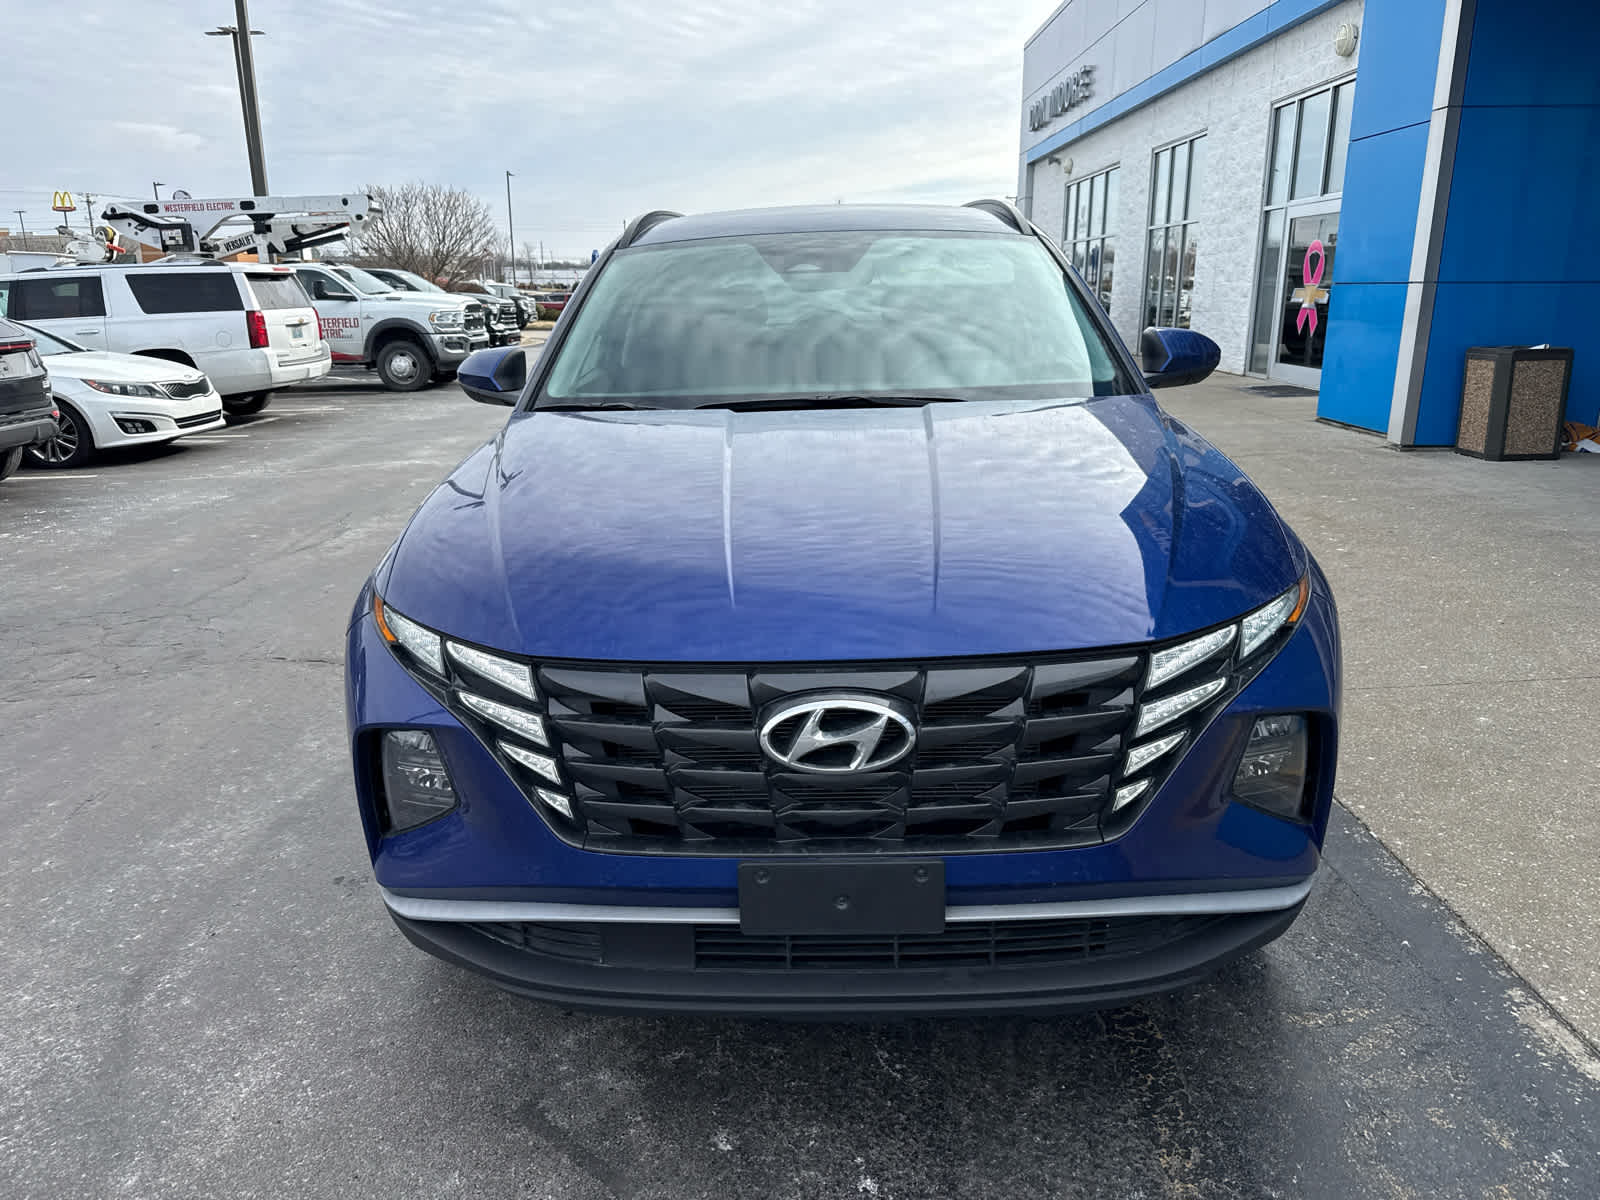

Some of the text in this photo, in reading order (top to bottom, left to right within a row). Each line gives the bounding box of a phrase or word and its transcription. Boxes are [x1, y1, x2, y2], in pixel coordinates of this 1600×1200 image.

[164, 202, 235, 212] WESTERFIELD ELECTRIC
[223, 234, 255, 252] VERSALIFT
